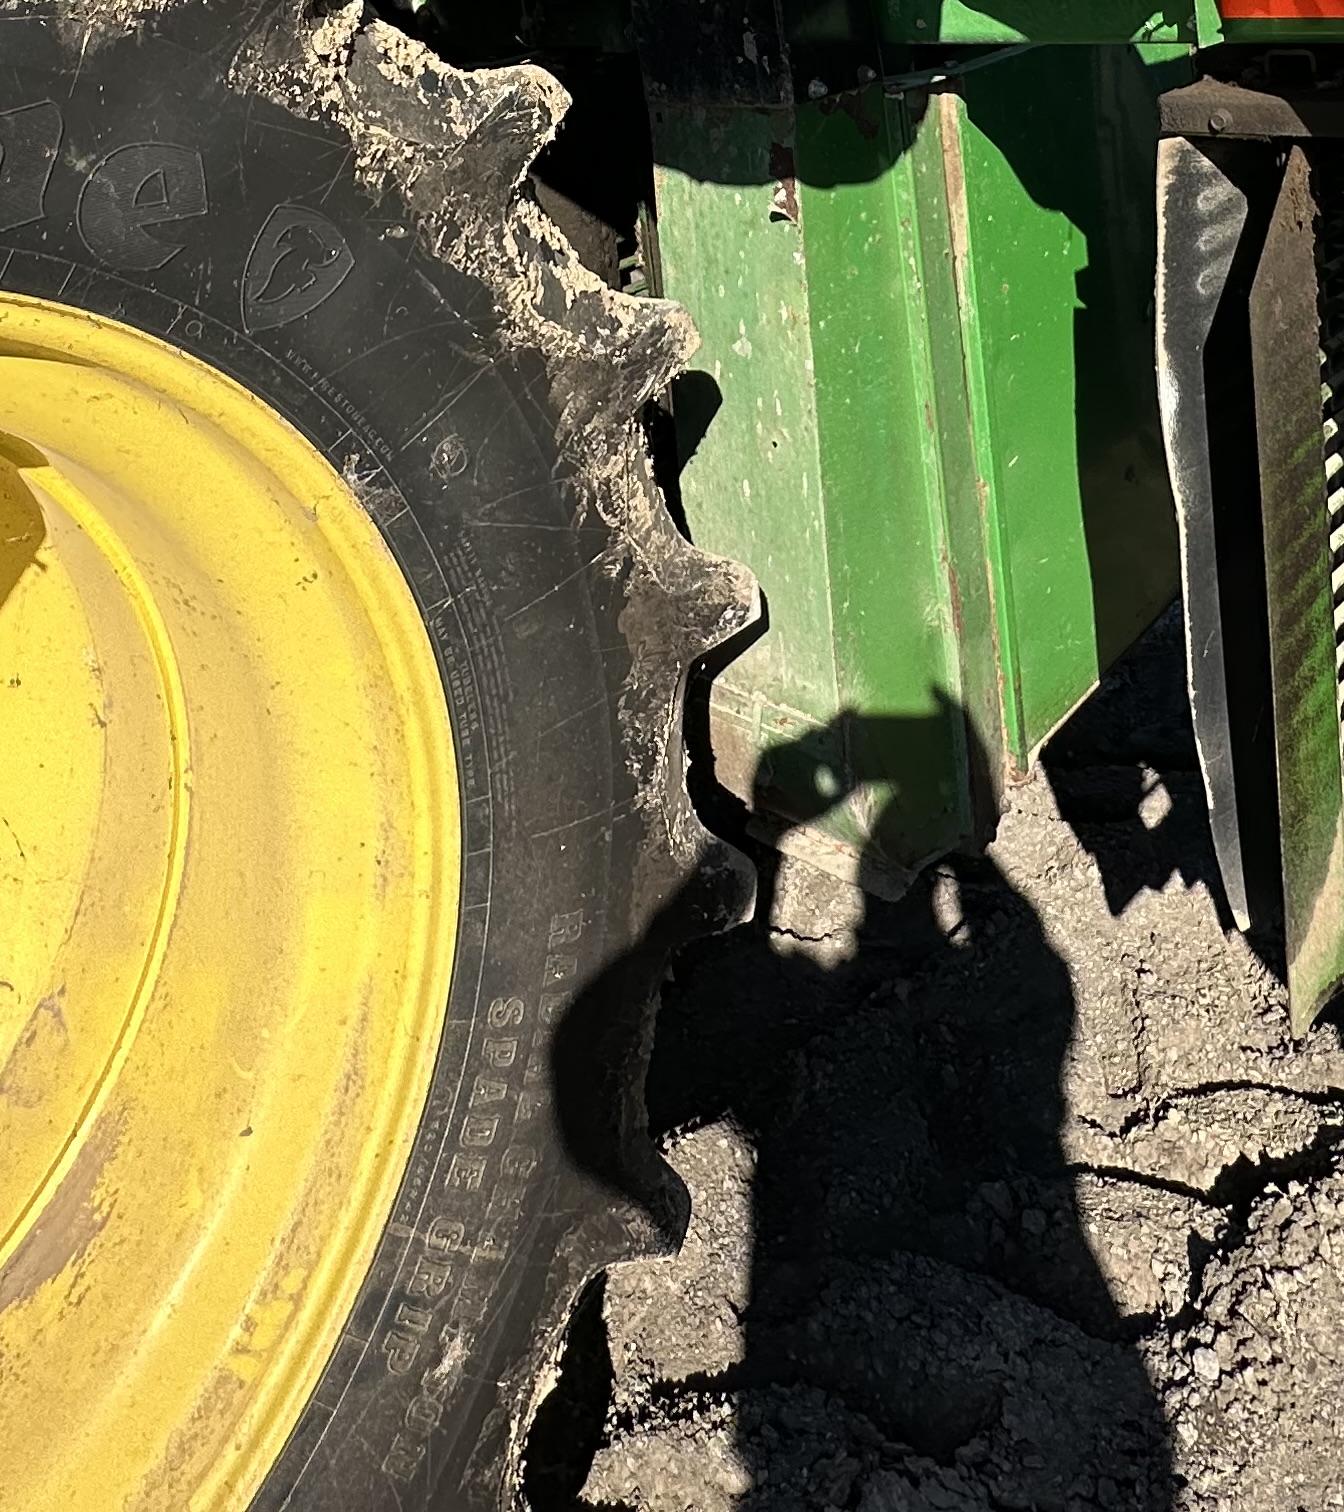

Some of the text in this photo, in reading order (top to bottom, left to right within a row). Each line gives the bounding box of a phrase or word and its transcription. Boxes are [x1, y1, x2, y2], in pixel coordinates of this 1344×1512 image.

[432, 615, 475, 789] MAY BE USED TUBE TYPE
[457, 659, 480, 732] TUBELESS
[382, 996, 526, 1375] SPADE GRIP
